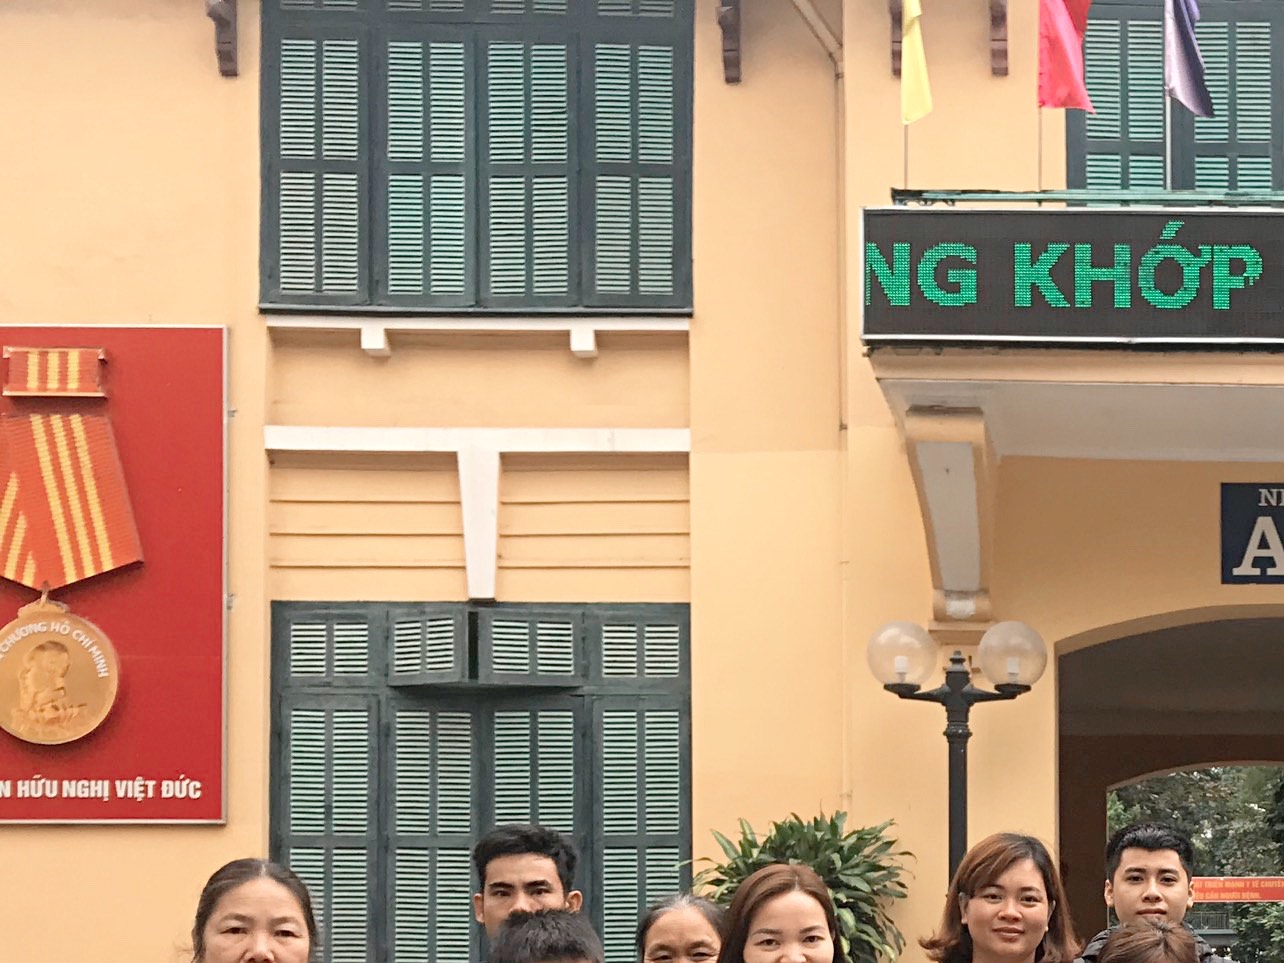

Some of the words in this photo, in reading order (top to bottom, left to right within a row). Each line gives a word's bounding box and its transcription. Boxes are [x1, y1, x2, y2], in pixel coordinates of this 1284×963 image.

[1014, 219, 1263, 310] KHỚP
[88, 645, 110, 679] MINH
[16, 774, 58, 799] HỮU
[62, 779, 110, 802] NGHỊ
[115, 776, 157, 802] VIỆT
[161, 774, 202, 800] ĐỨC
